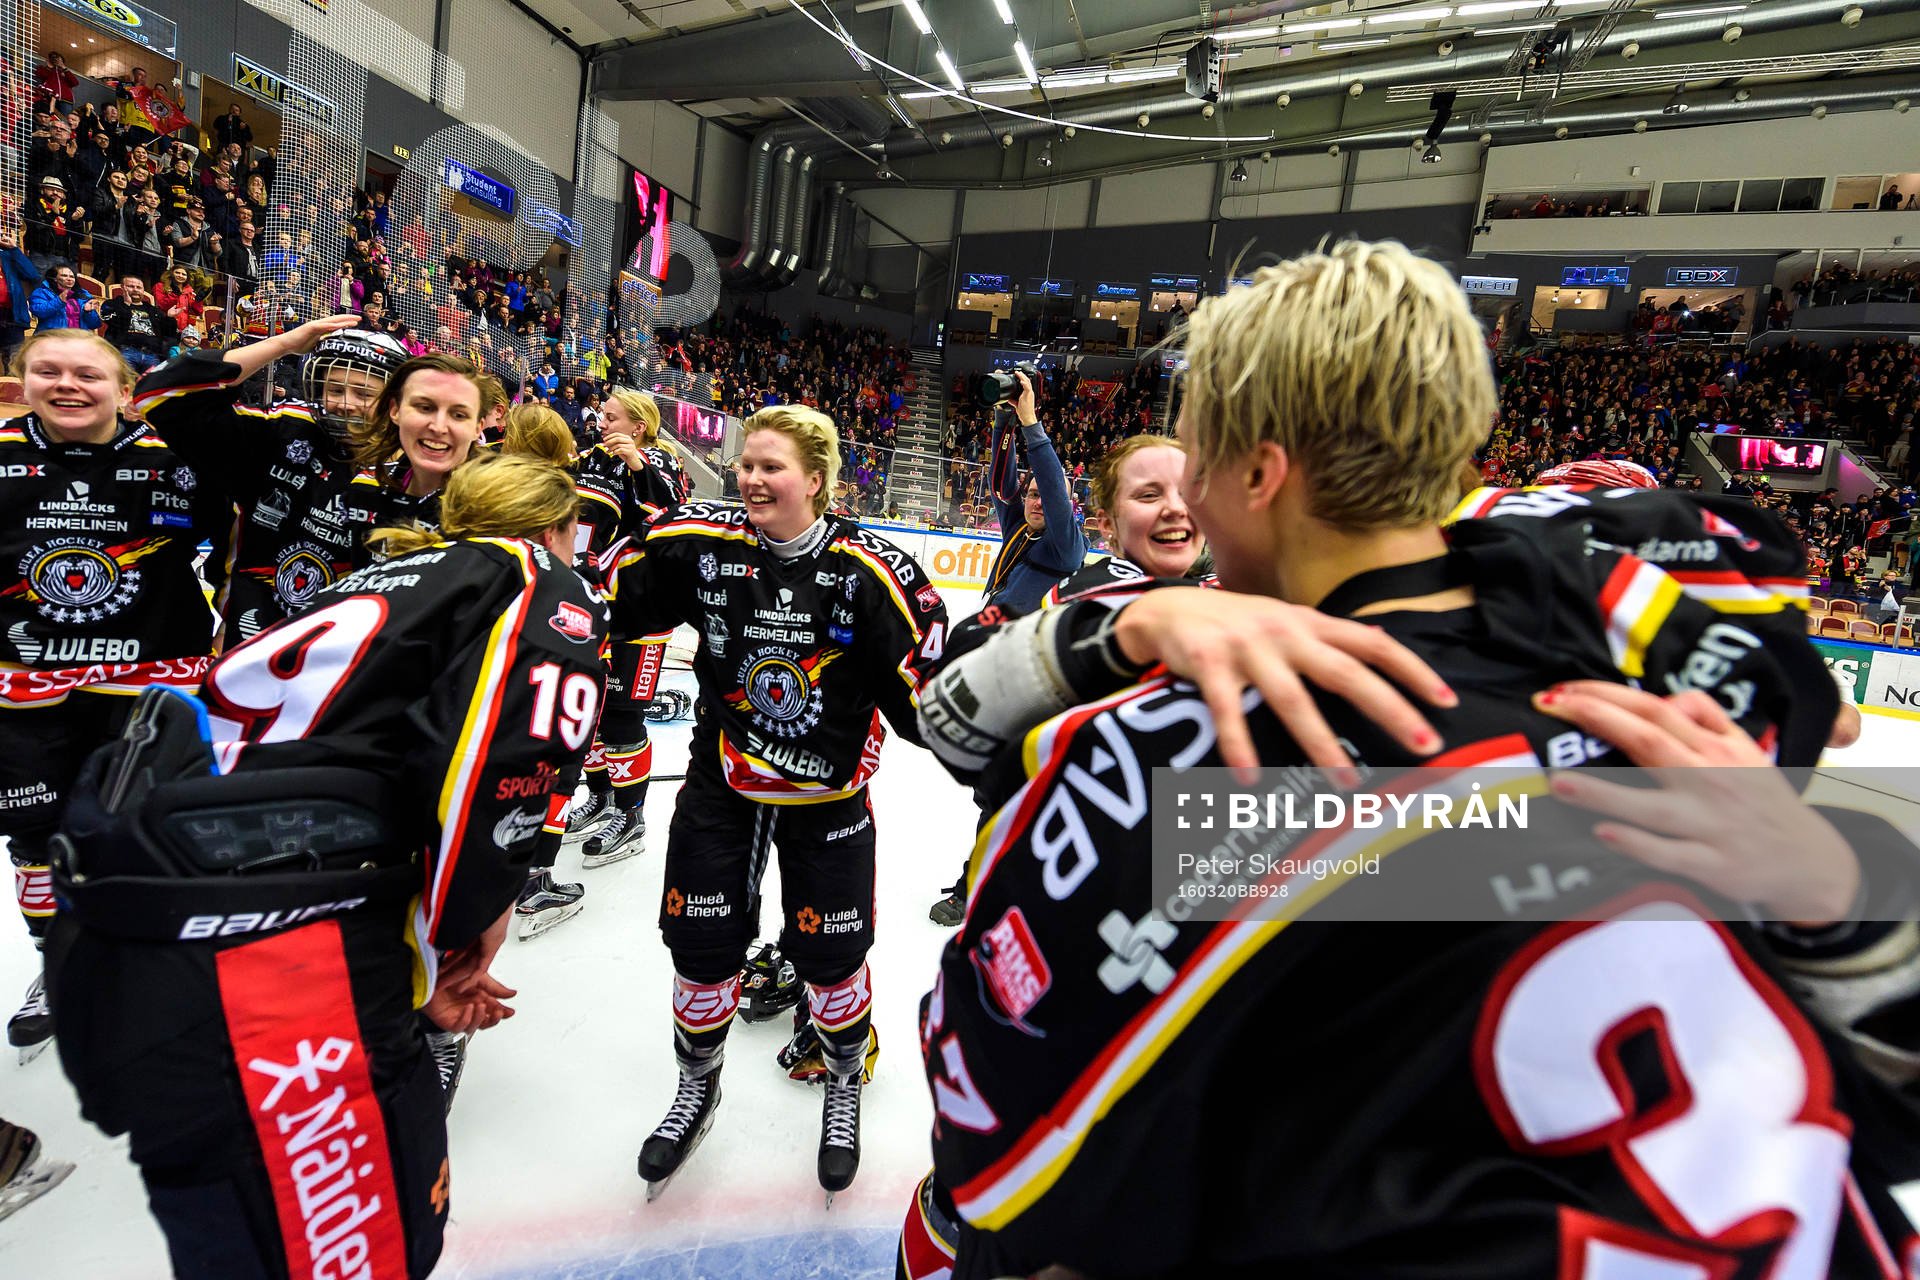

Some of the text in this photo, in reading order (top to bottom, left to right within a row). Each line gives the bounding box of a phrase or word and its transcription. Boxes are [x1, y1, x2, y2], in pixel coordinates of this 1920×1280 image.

[466, 171, 497, 195] Student
[464, 181, 503, 208] Consulting
[1676, 270, 1728, 282] BDX
[115, 469, 166, 482] BDX
[151, 491, 189, 510] Pite
[26, 517, 128, 533] HERMELINEN
[45, 536, 105, 549] HOCKEY
[811, 520, 841, 560] BAUER
[303, 541, 335, 562] OCKEY
[850, 529, 915, 587] SSAB
[933, 542, 996, 578] offi
[720, 563, 761, 580] BDX
[44, 637, 141, 662] LULEBO
[919, 621, 945, 661] 4
[757, 646, 801, 662] HOCKEY
[530, 663, 598, 751] 19
[687, 892, 725, 905] Luleå
[686, 904, 731, 918] Energi
[824, 907, 858, 922] Luleå
[823, 919, 863, 934] Energi
